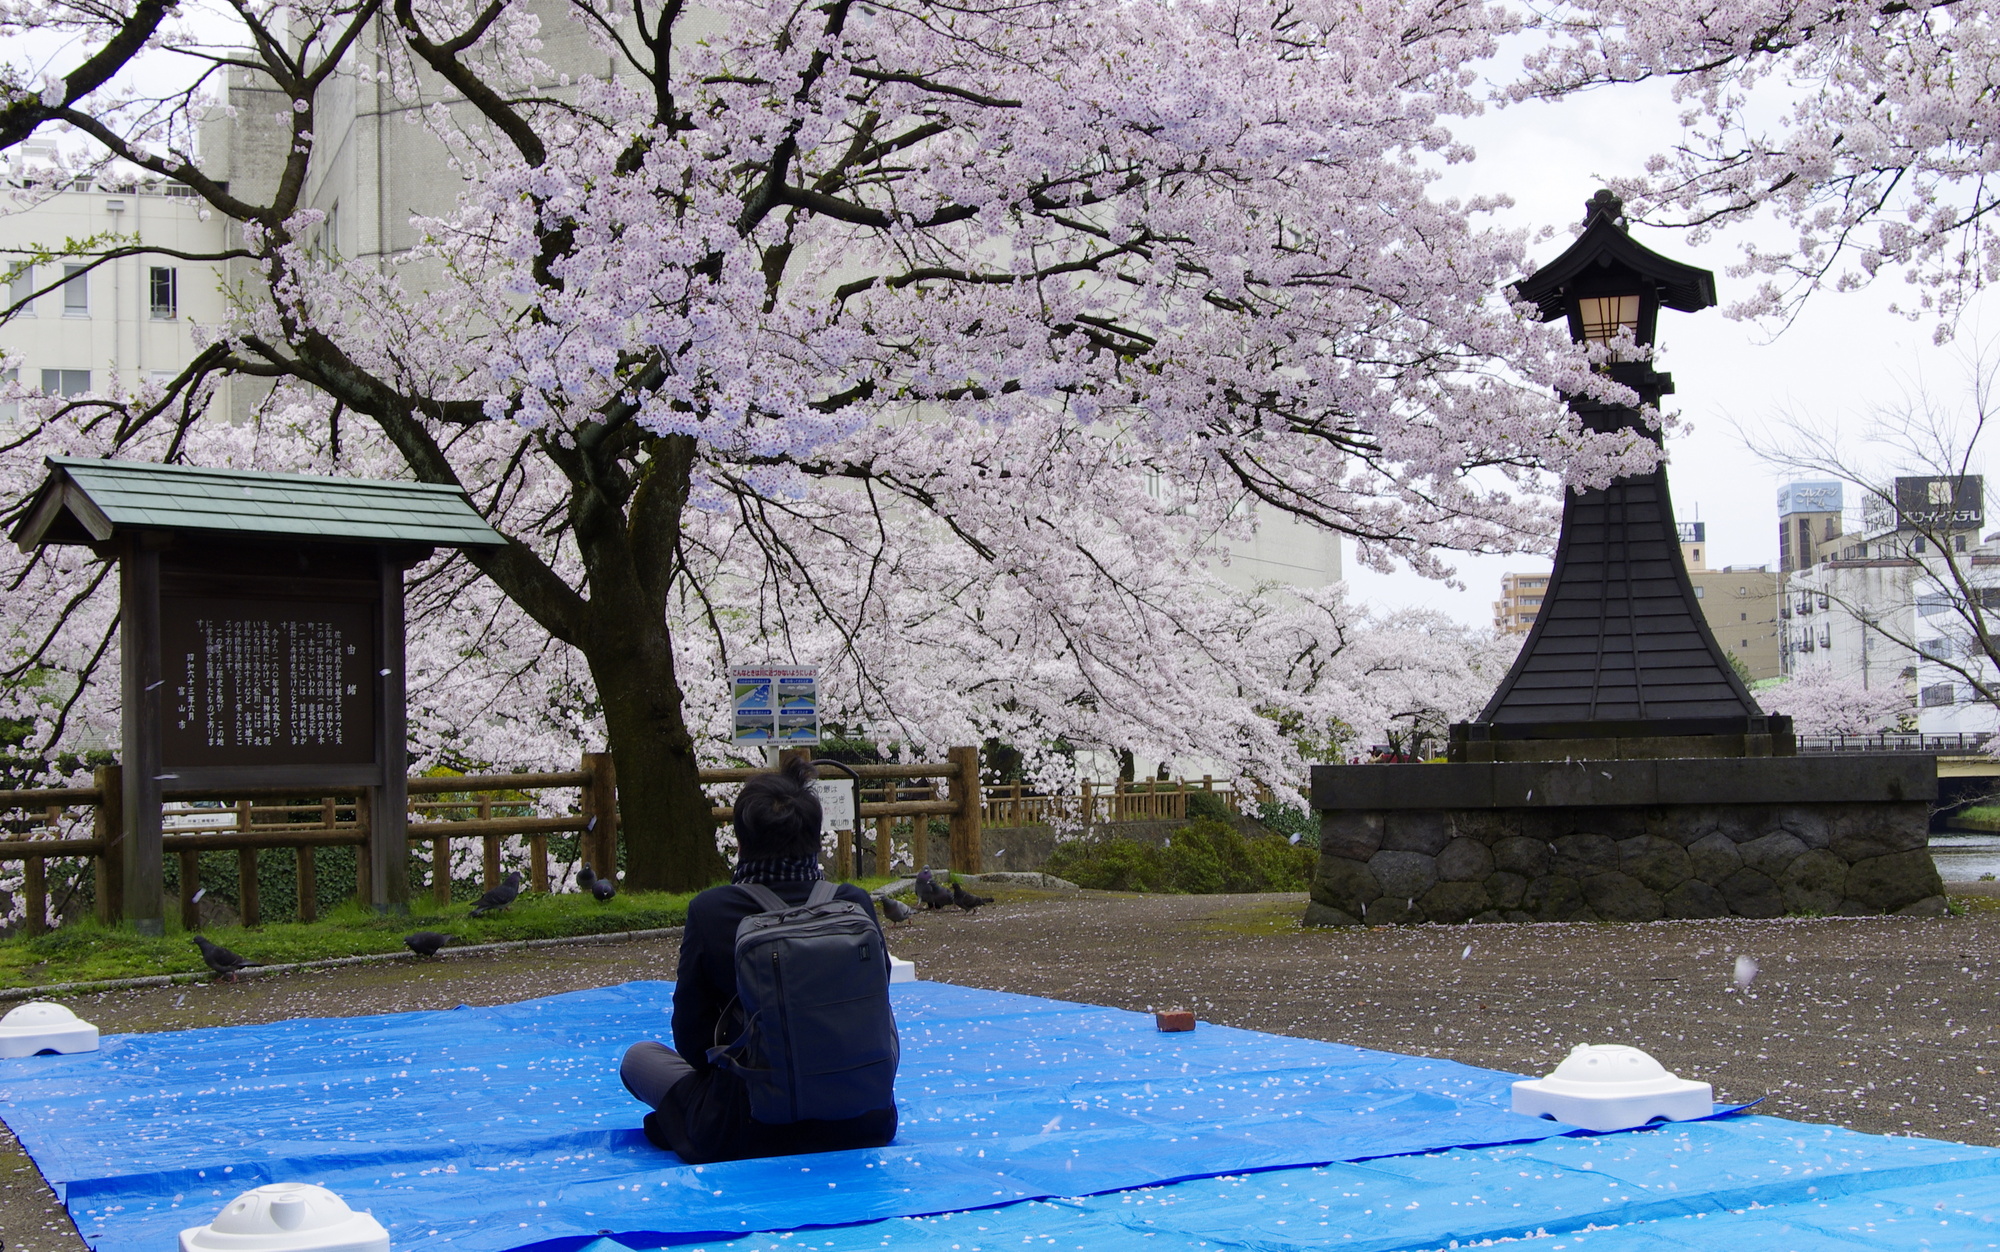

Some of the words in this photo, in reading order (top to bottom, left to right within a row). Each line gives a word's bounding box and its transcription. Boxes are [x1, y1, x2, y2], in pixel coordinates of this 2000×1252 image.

[186, 652, 195, 721] 昭和六十三年六月
[732, 668, 817, 677] こんなときは川に近づかないようにしよう
[177, 685, 186, 730] 富山市
